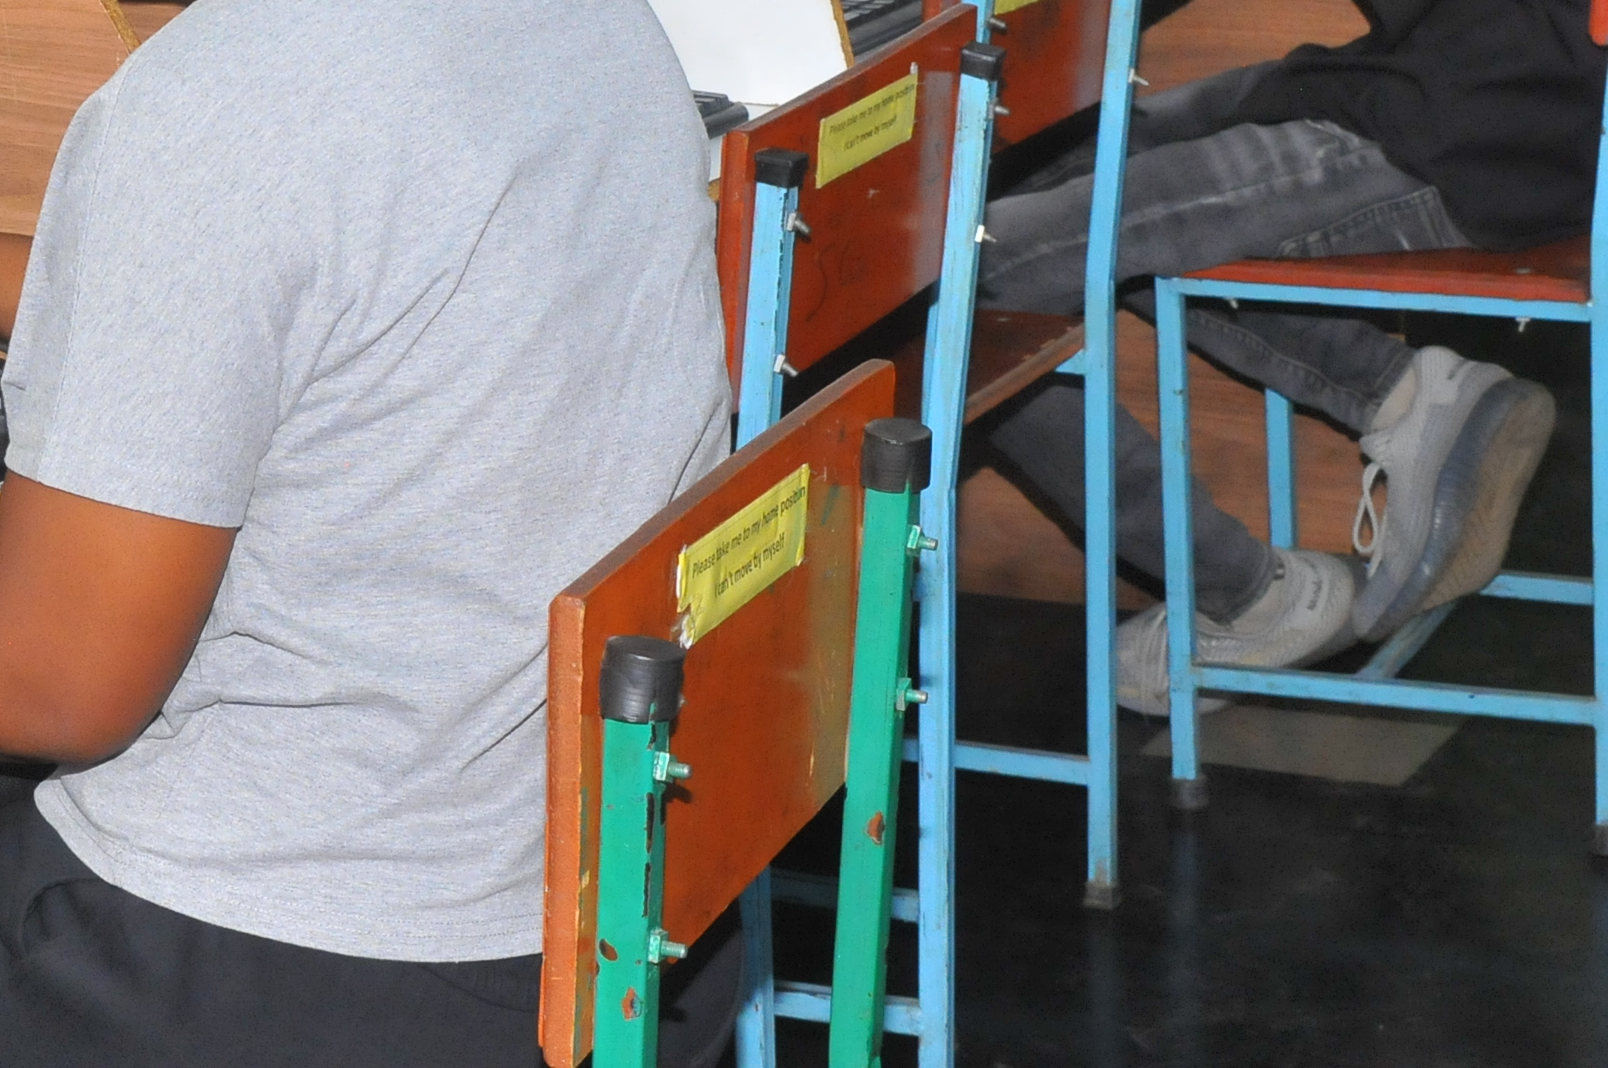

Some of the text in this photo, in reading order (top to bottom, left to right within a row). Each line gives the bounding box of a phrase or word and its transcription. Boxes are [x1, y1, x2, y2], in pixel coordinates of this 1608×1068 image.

[692, 553, 715, 578] Please
[716, 543, 730, 561] take
[731, 537, 742, 549] me
[743, 528, 751, 540] to
[751, 520, 762, 536] my
[762, 505, 779, 527] home
[734, 562, 753, 581] move
[753, 553, 762, 570] by
[762, 532, 786, 564] myself
